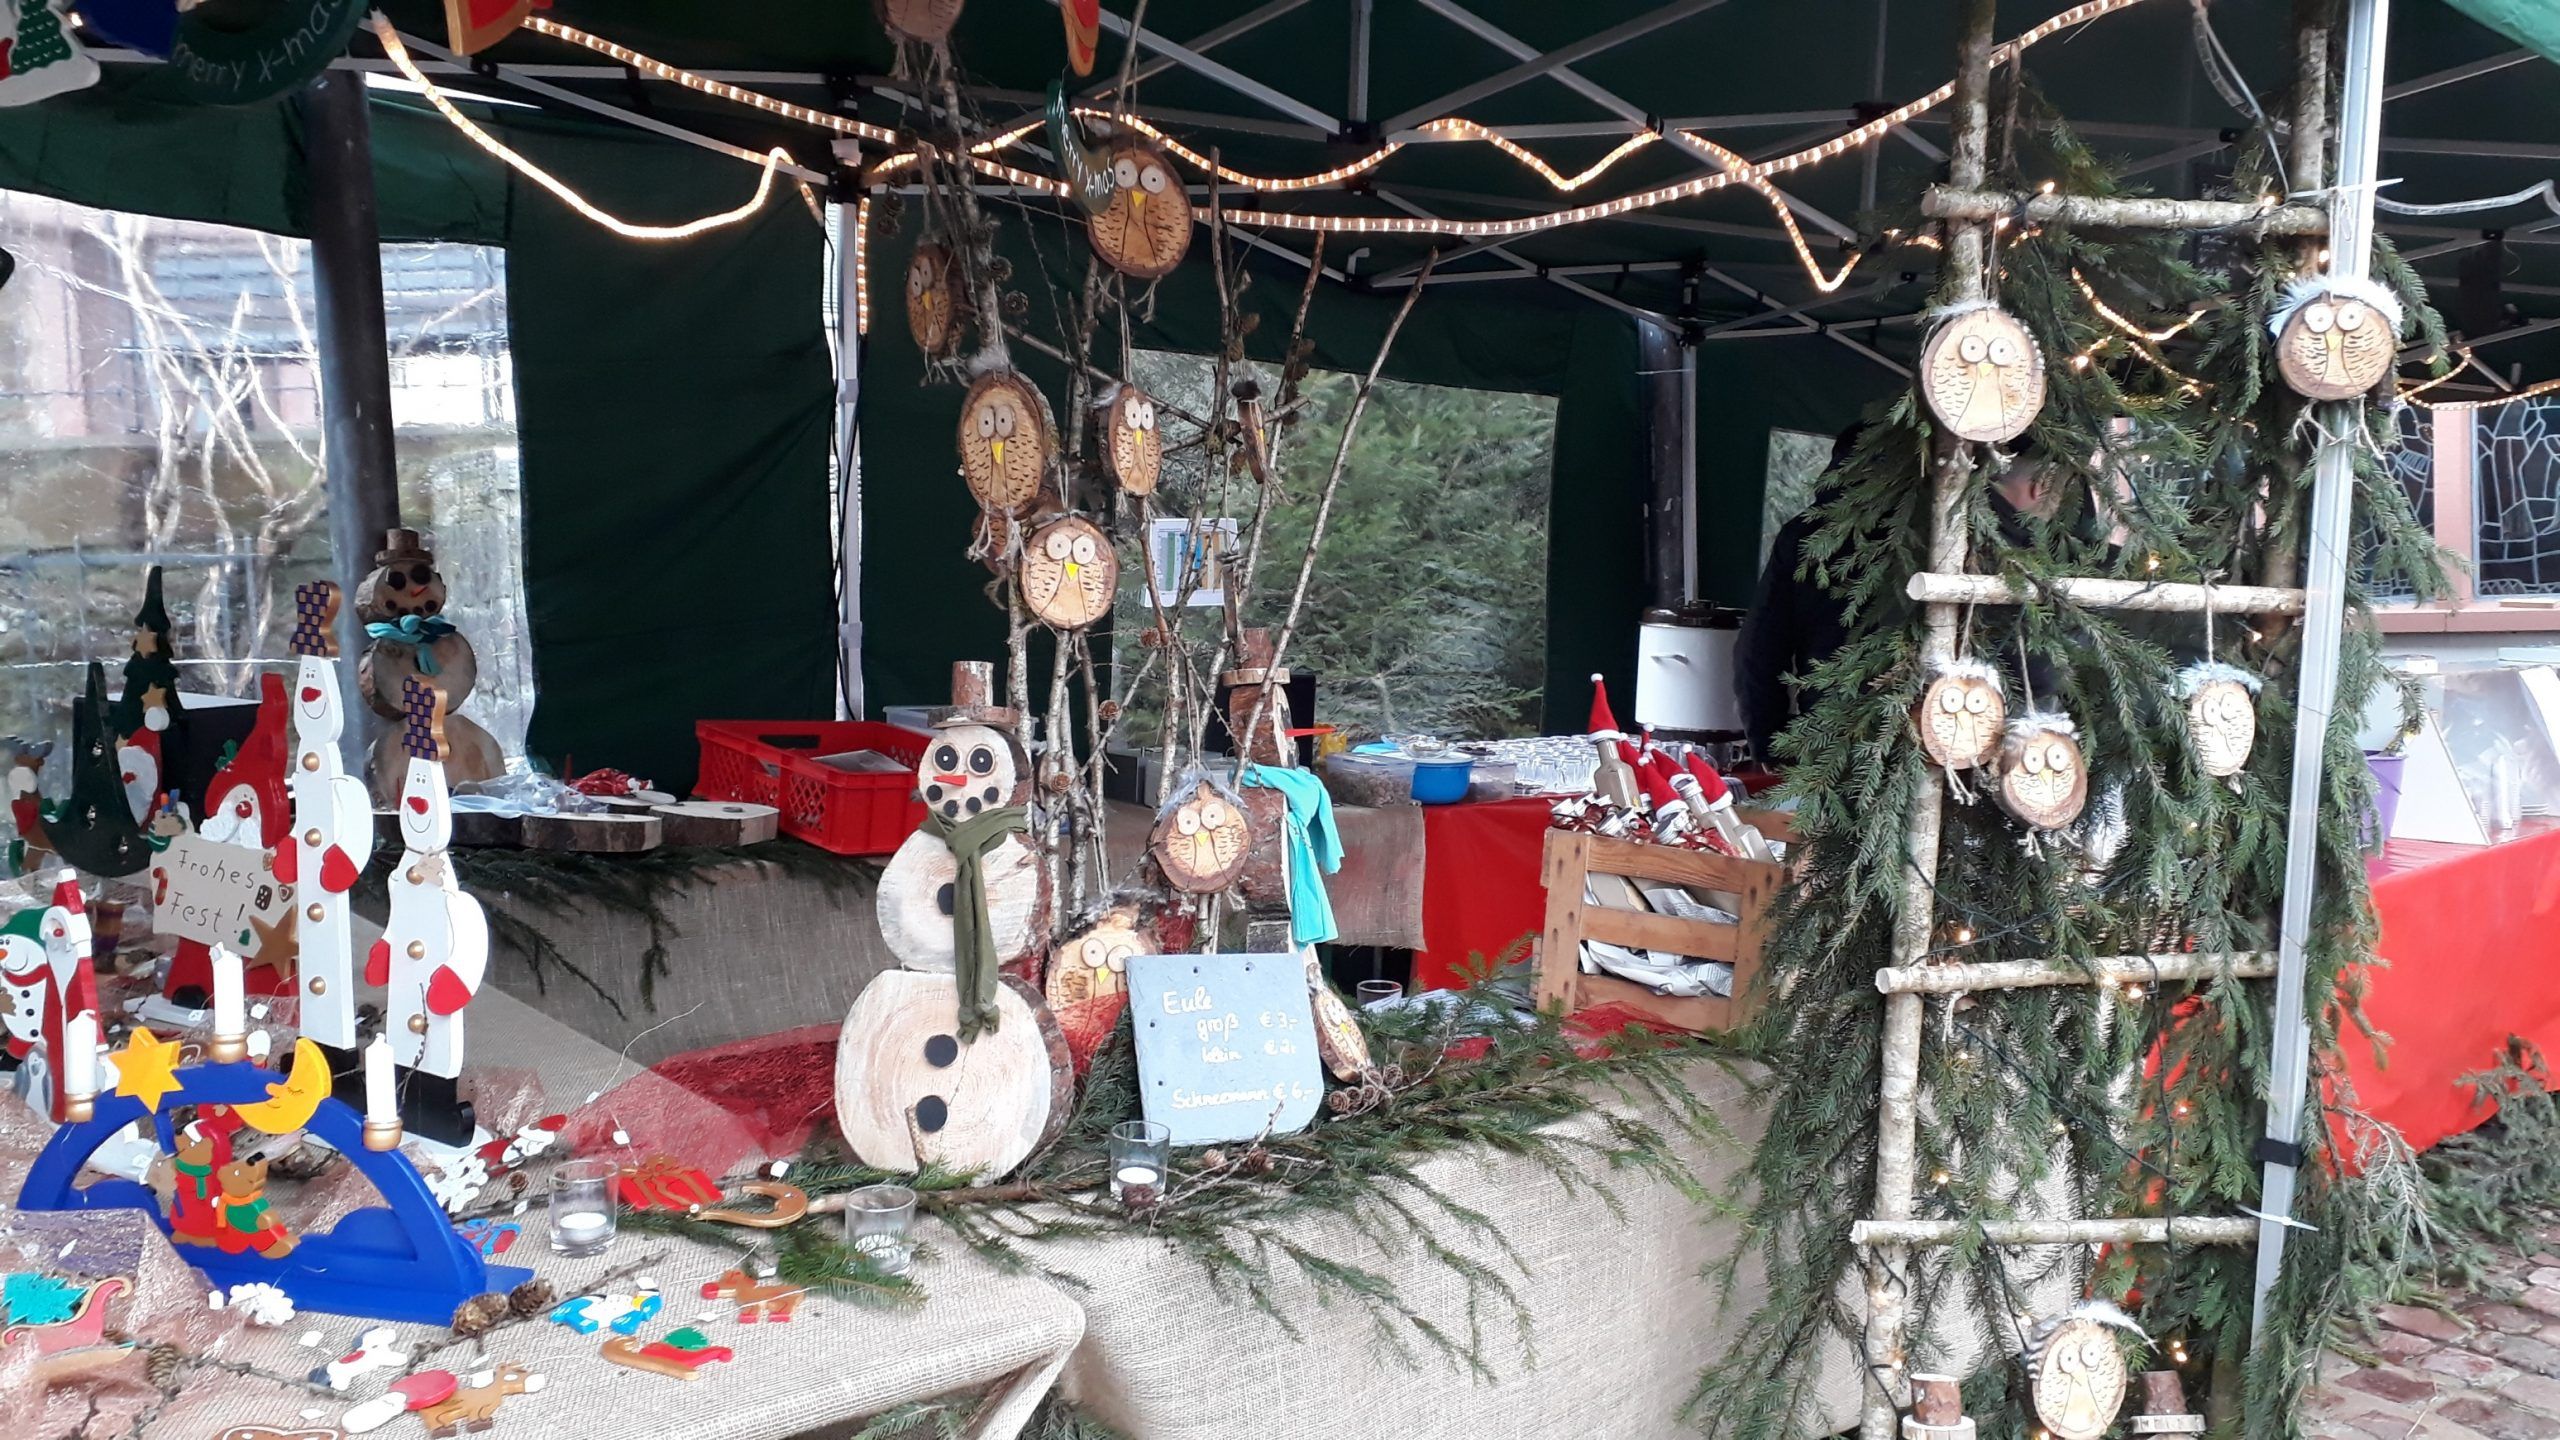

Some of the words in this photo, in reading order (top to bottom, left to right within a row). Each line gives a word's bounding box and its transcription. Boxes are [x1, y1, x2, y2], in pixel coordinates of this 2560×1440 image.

[178, 849, 254, 889] Frohes
[1162, 986, 1213, 1015] Eule
[1197, 1012, 1239, 1042] groß
